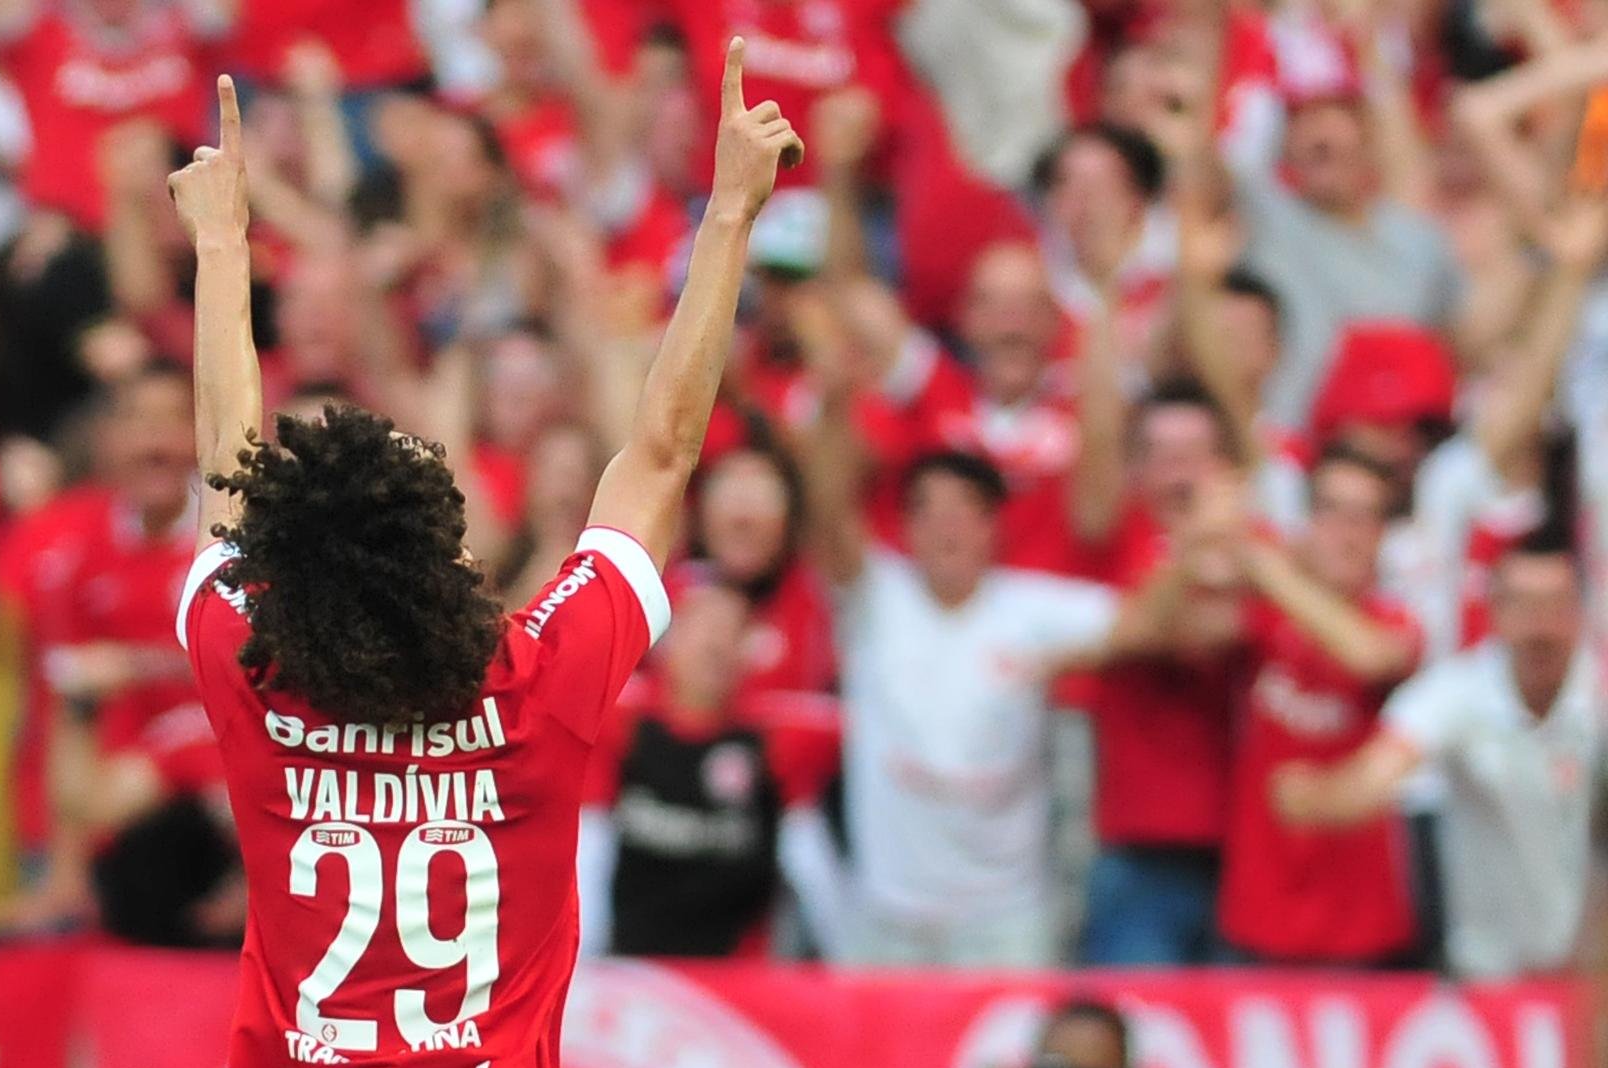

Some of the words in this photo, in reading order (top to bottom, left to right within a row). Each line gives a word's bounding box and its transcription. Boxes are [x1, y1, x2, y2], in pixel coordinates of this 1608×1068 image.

[265, 697, 506, 757] Banrisul
[284, 764, 505, 823] VALDÍVIA
[330, 832, 355, 845] TIM
[444, 829, 469, 842] TIM
[289, 819, 500, 1054] 29
